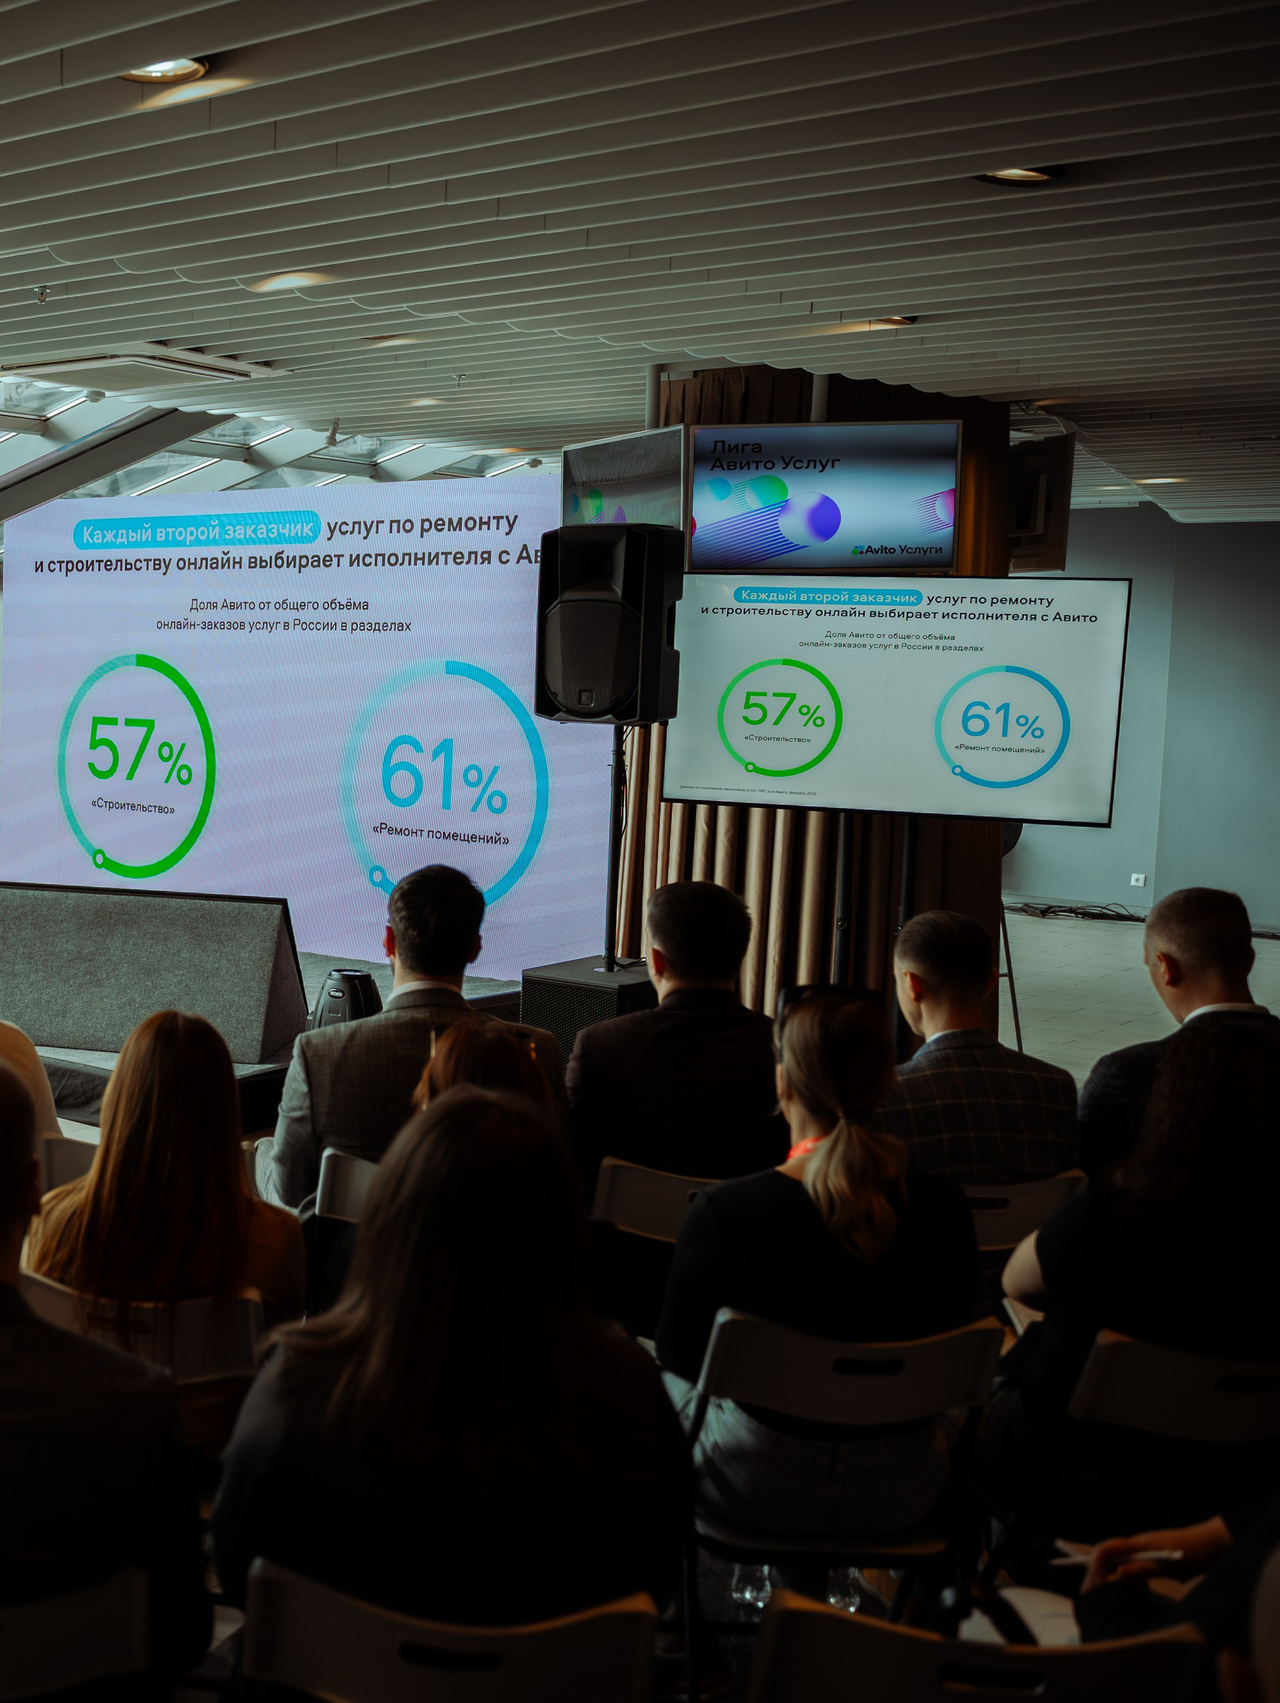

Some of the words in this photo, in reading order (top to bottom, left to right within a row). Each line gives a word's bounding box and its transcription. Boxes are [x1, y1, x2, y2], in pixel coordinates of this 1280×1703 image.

[711, 440, 763, 454] Лига
[710, 457, 775, 471] Авито
[781, 456, 841, 473] Услуг
[83, 522, 152, 545] Каждый
[157, 520, 219, 545] второй
[225, 520, 313, 540] заказчик
[327, 519, 385, 542] услуг
[389, 519, 414, 534] по
[420, 514, 518, 540] ремонту
[865, 545, 896, 555] Avito
[898, 545, 943, 556] Услуги
[34, 559, 45, 572] и
[48, 556, 172, 577] строительству
[176, 550, 243, 570] онлайн
[248, 549, 344, 573] выбирает
[349, 549, 492, 568] исполнителя
[498, 549, 510, 565] с
[190, 599, 218, 613] Доля
[221, 599, 255, 611] Авито
[259, 601, 271, 611] от
[274, 598, 319, 613] общего
[322, 597, 369, 611] объёма
[741, 590, 796, 602] Каждый
[800, 591, 849, 603] второй
[852, 592, 917, 603] заказчик
[927, 595, 967, 606] услуг
[970, 595, 987, 604] по
[991, 595, 1054, 608] ремонту
[712, 607, 812, 619] строительству
[815, 606, 865, 618] онлайн
[869, 608, 939, 621] выбирает
[942, 611, 1037, 622] исполнителя
[1041, 614, 1049, 622] с
[1052, 612, 1098, 623] Авито
[156, 618, 245, 630] онлайн-заказов
[248, 620, 280, 633] услуг
[283, 621, 289, 631] в
[293, 619, 337, 631] России
[341, 621, 347, 631] в
[351, 618, 412, 634] разделах
[825, 630, 847, 640] Доля
[849, 631, 874, 640] Авито
[888, 632, 920, 642] общего
[923, 632, 956, 641] объёма
[799, 640, 867, 649] онлайн-заказов
[869, 643, 891, 651] услуг
[902, 643, 932, 651] России
[942, 645, 984, 653] разделах
[742, 691, 825, 729] 57%
[961, 700, 1045, 739] 61%
[744, 733, 811, 745] «Строительство»
[87, 716, 193, 786] 57%
[955, 743, 990, 753] «Ремонт
[991, 745, 1045, 755] помещений»
[381, 734, 508, 815] 61%
[91, 796, 175, 815] «Строительство»
[372, 822, 424, 840] «Ремонт
[427, 828, 510, 846] помещений»
